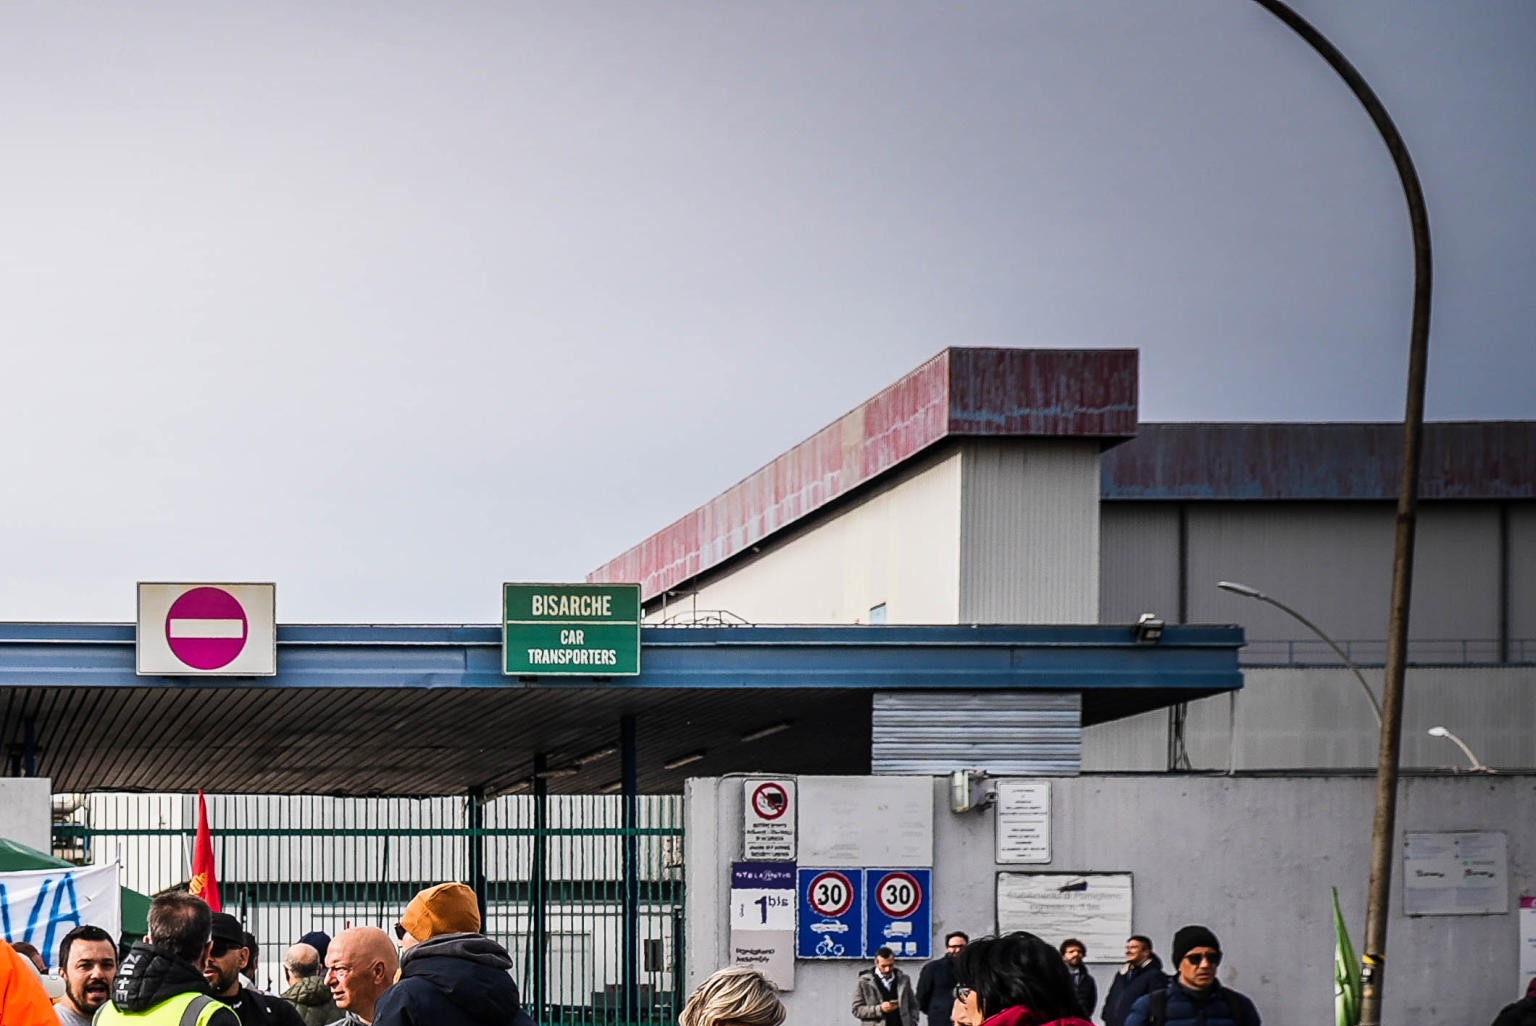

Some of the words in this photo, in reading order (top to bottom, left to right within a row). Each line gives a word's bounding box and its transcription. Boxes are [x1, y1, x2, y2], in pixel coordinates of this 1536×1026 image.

[531, 595, 612, 616] BISARCHE
[560, 629, 584, 645] CAR
[527, 648, 617, 665] TRANSPORTERS
[817, 884, 842, 906] 30
[885, 884, 911, 906] 30
